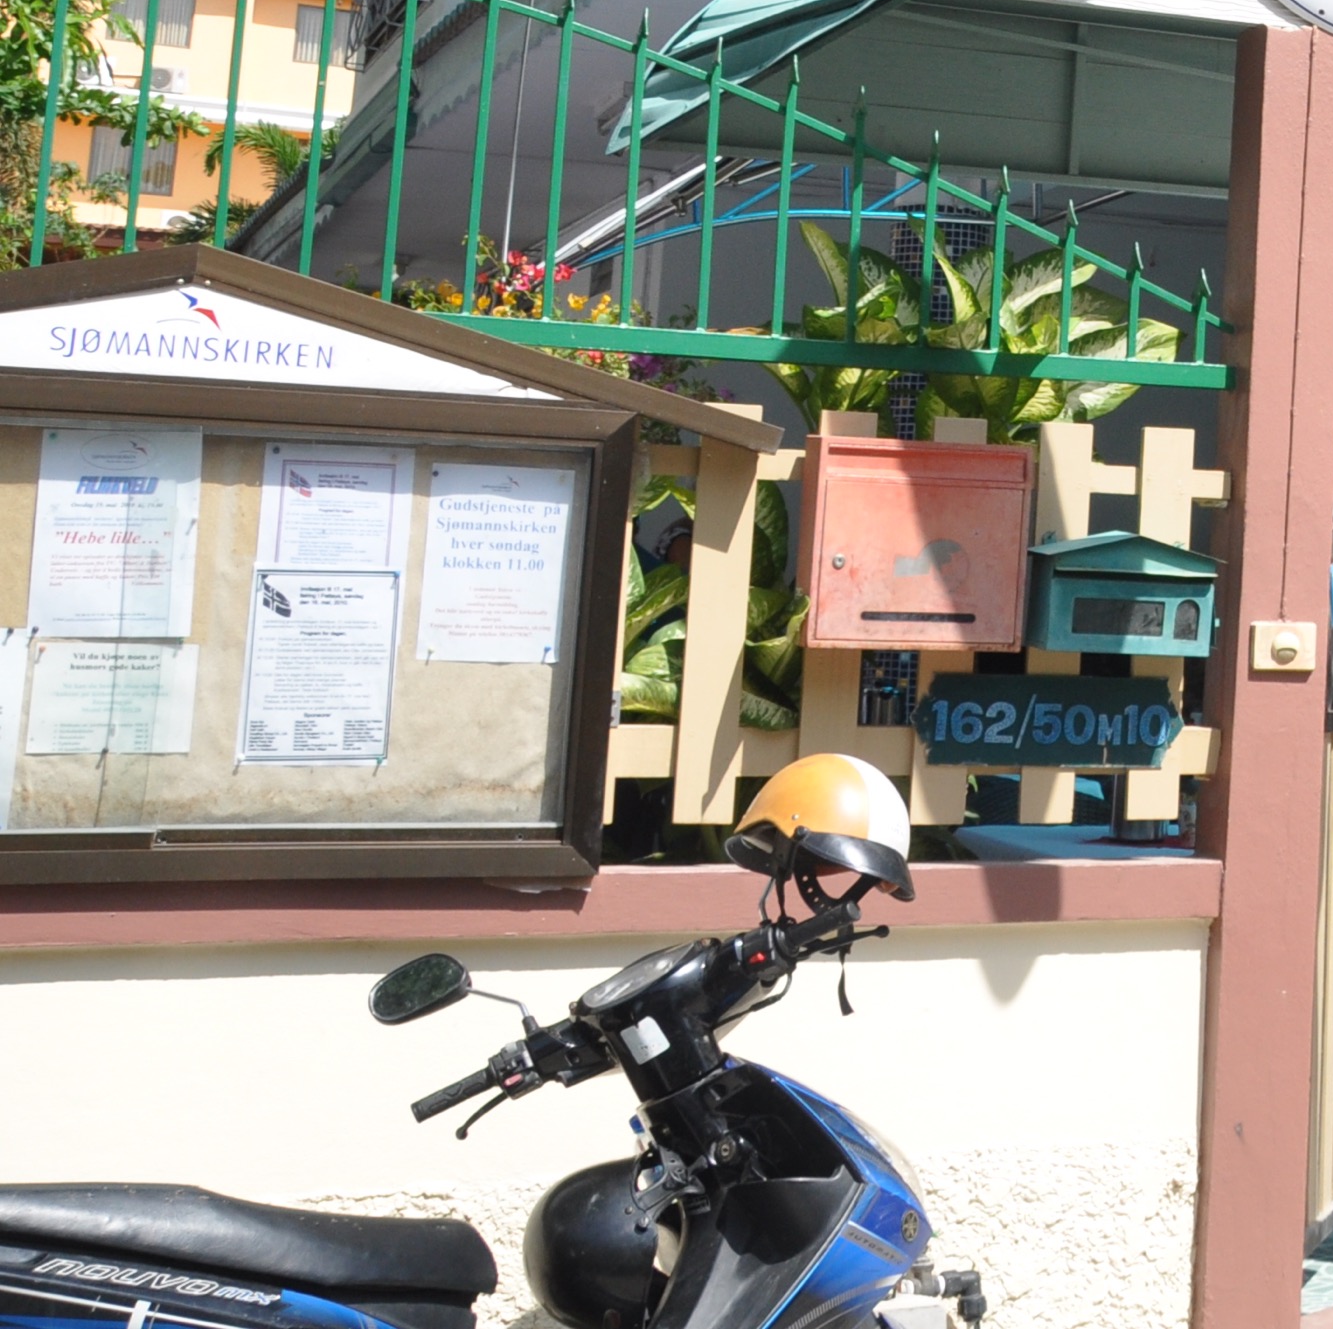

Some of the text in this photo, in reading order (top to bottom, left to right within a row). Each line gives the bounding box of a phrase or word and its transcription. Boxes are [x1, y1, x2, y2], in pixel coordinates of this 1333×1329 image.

[50, 326, 333, 369] SJØMANNSKIRKEN
[439, 498, 561, 517] Gudstjeneste på
[436, 517, 557, 534] Sjømannskirken
[451, 538, 539, 553] hver søndag
[442, 556, 544, 571] klokken 11.00
